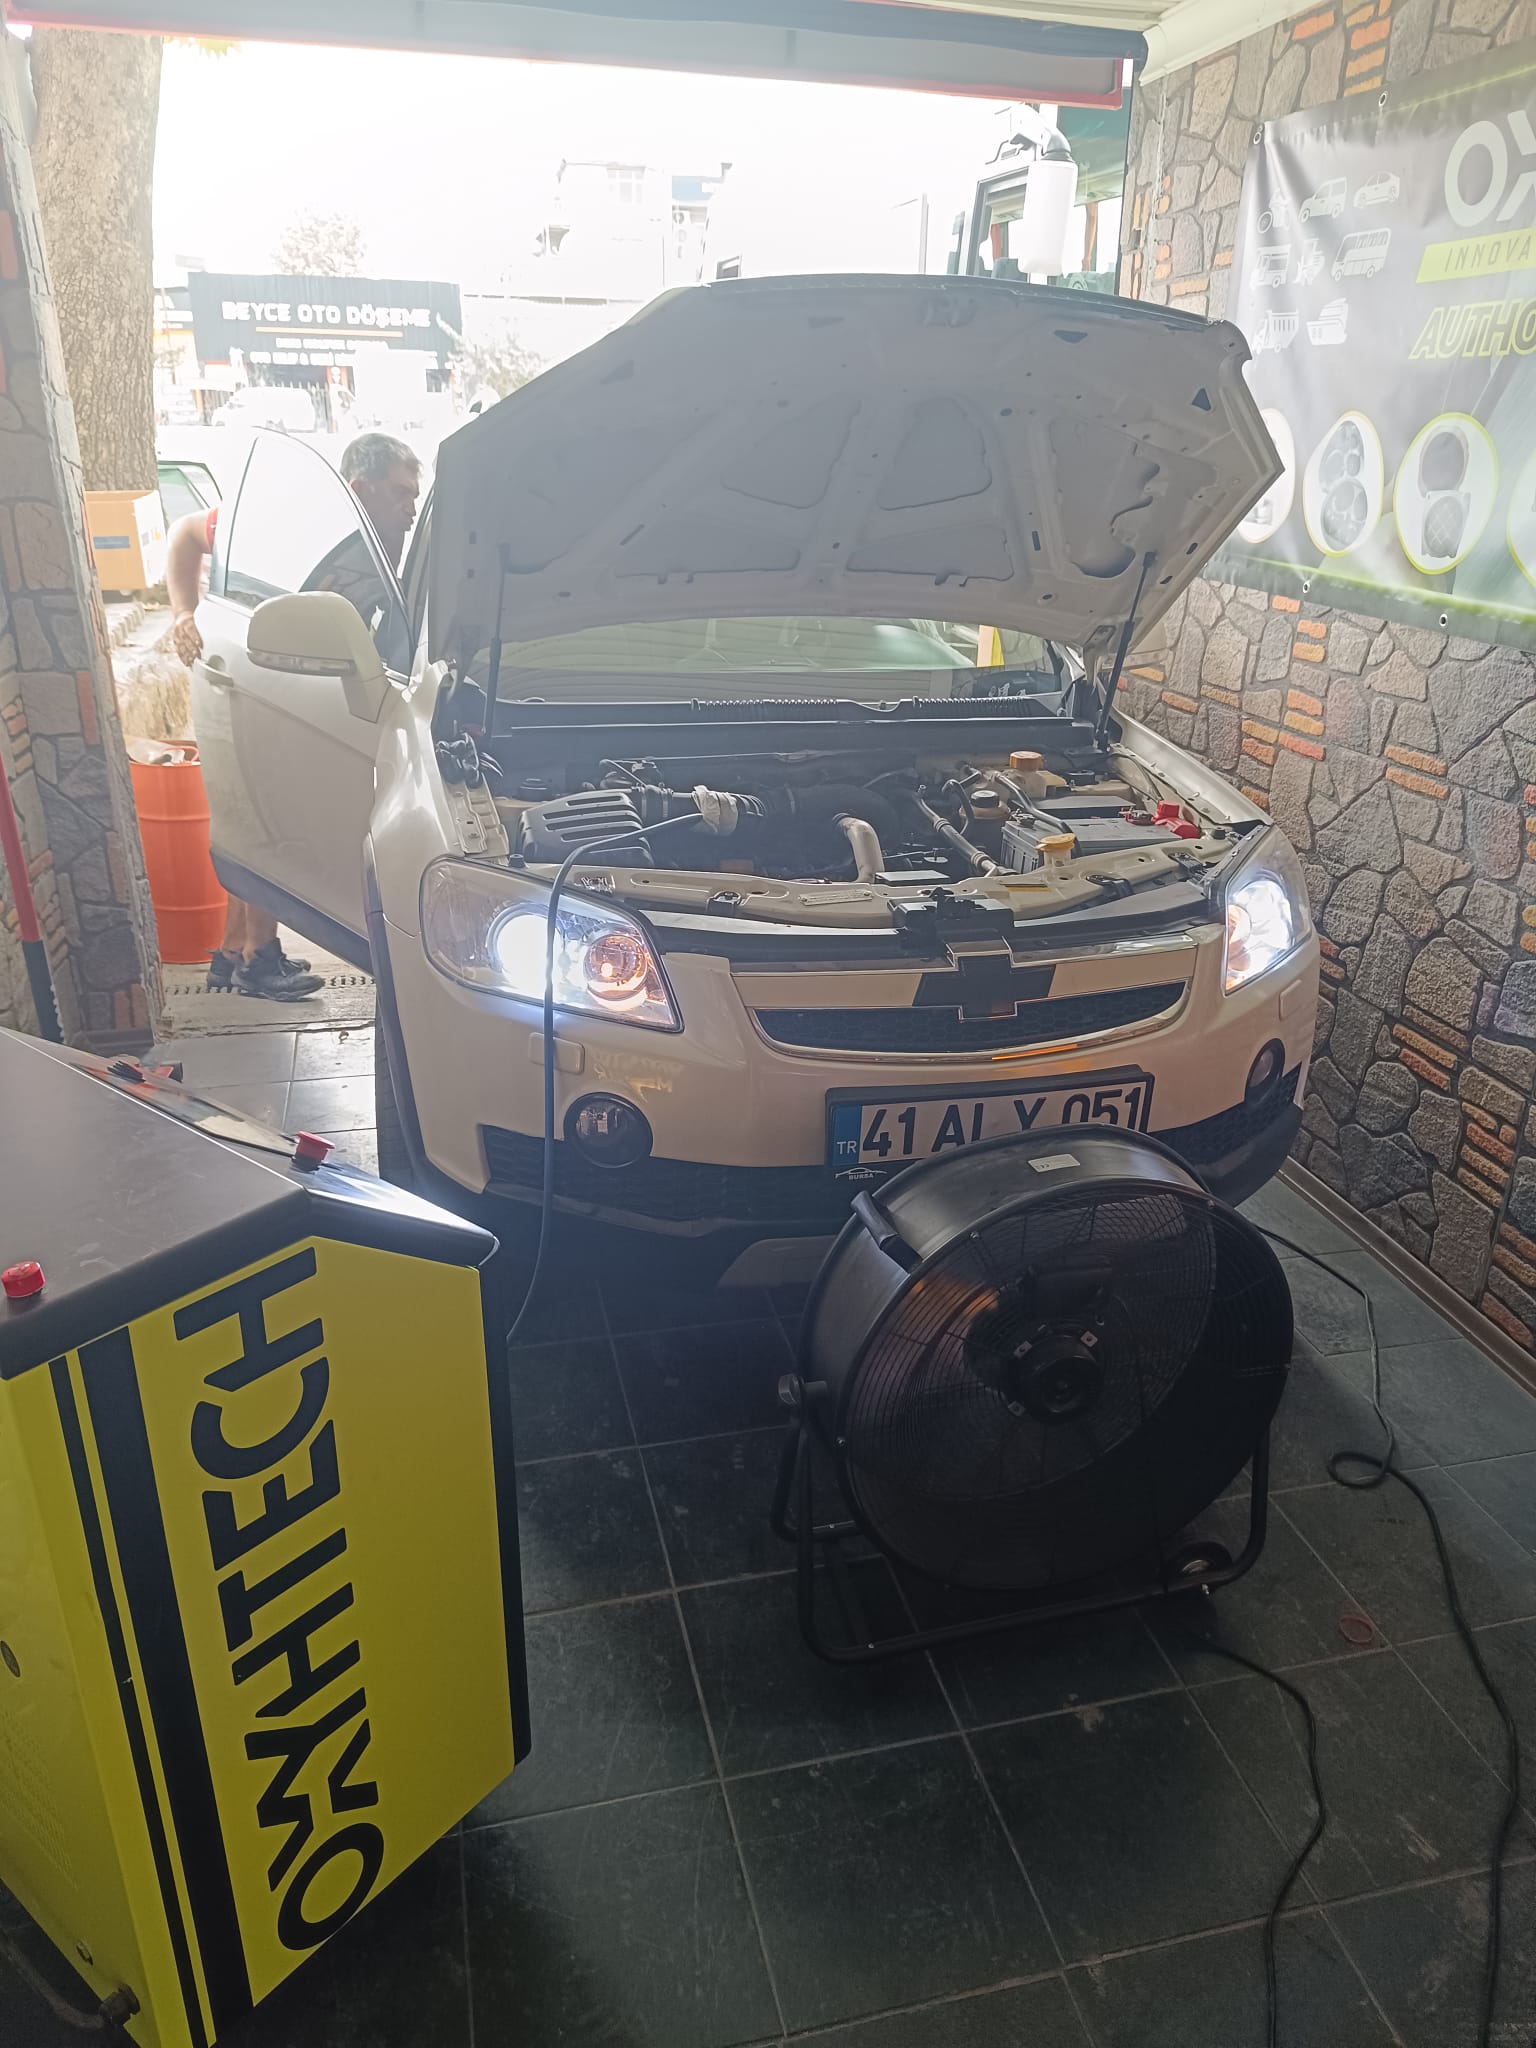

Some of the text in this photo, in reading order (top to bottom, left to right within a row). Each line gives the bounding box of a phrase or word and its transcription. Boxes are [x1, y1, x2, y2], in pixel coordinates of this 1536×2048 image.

[297, 304, 341, 324] OTO
[345, 303, 431, 329] DÖŞEME
[862, 1108, 916, 1157] 41
[836, 1140, 857, 1155] TR
